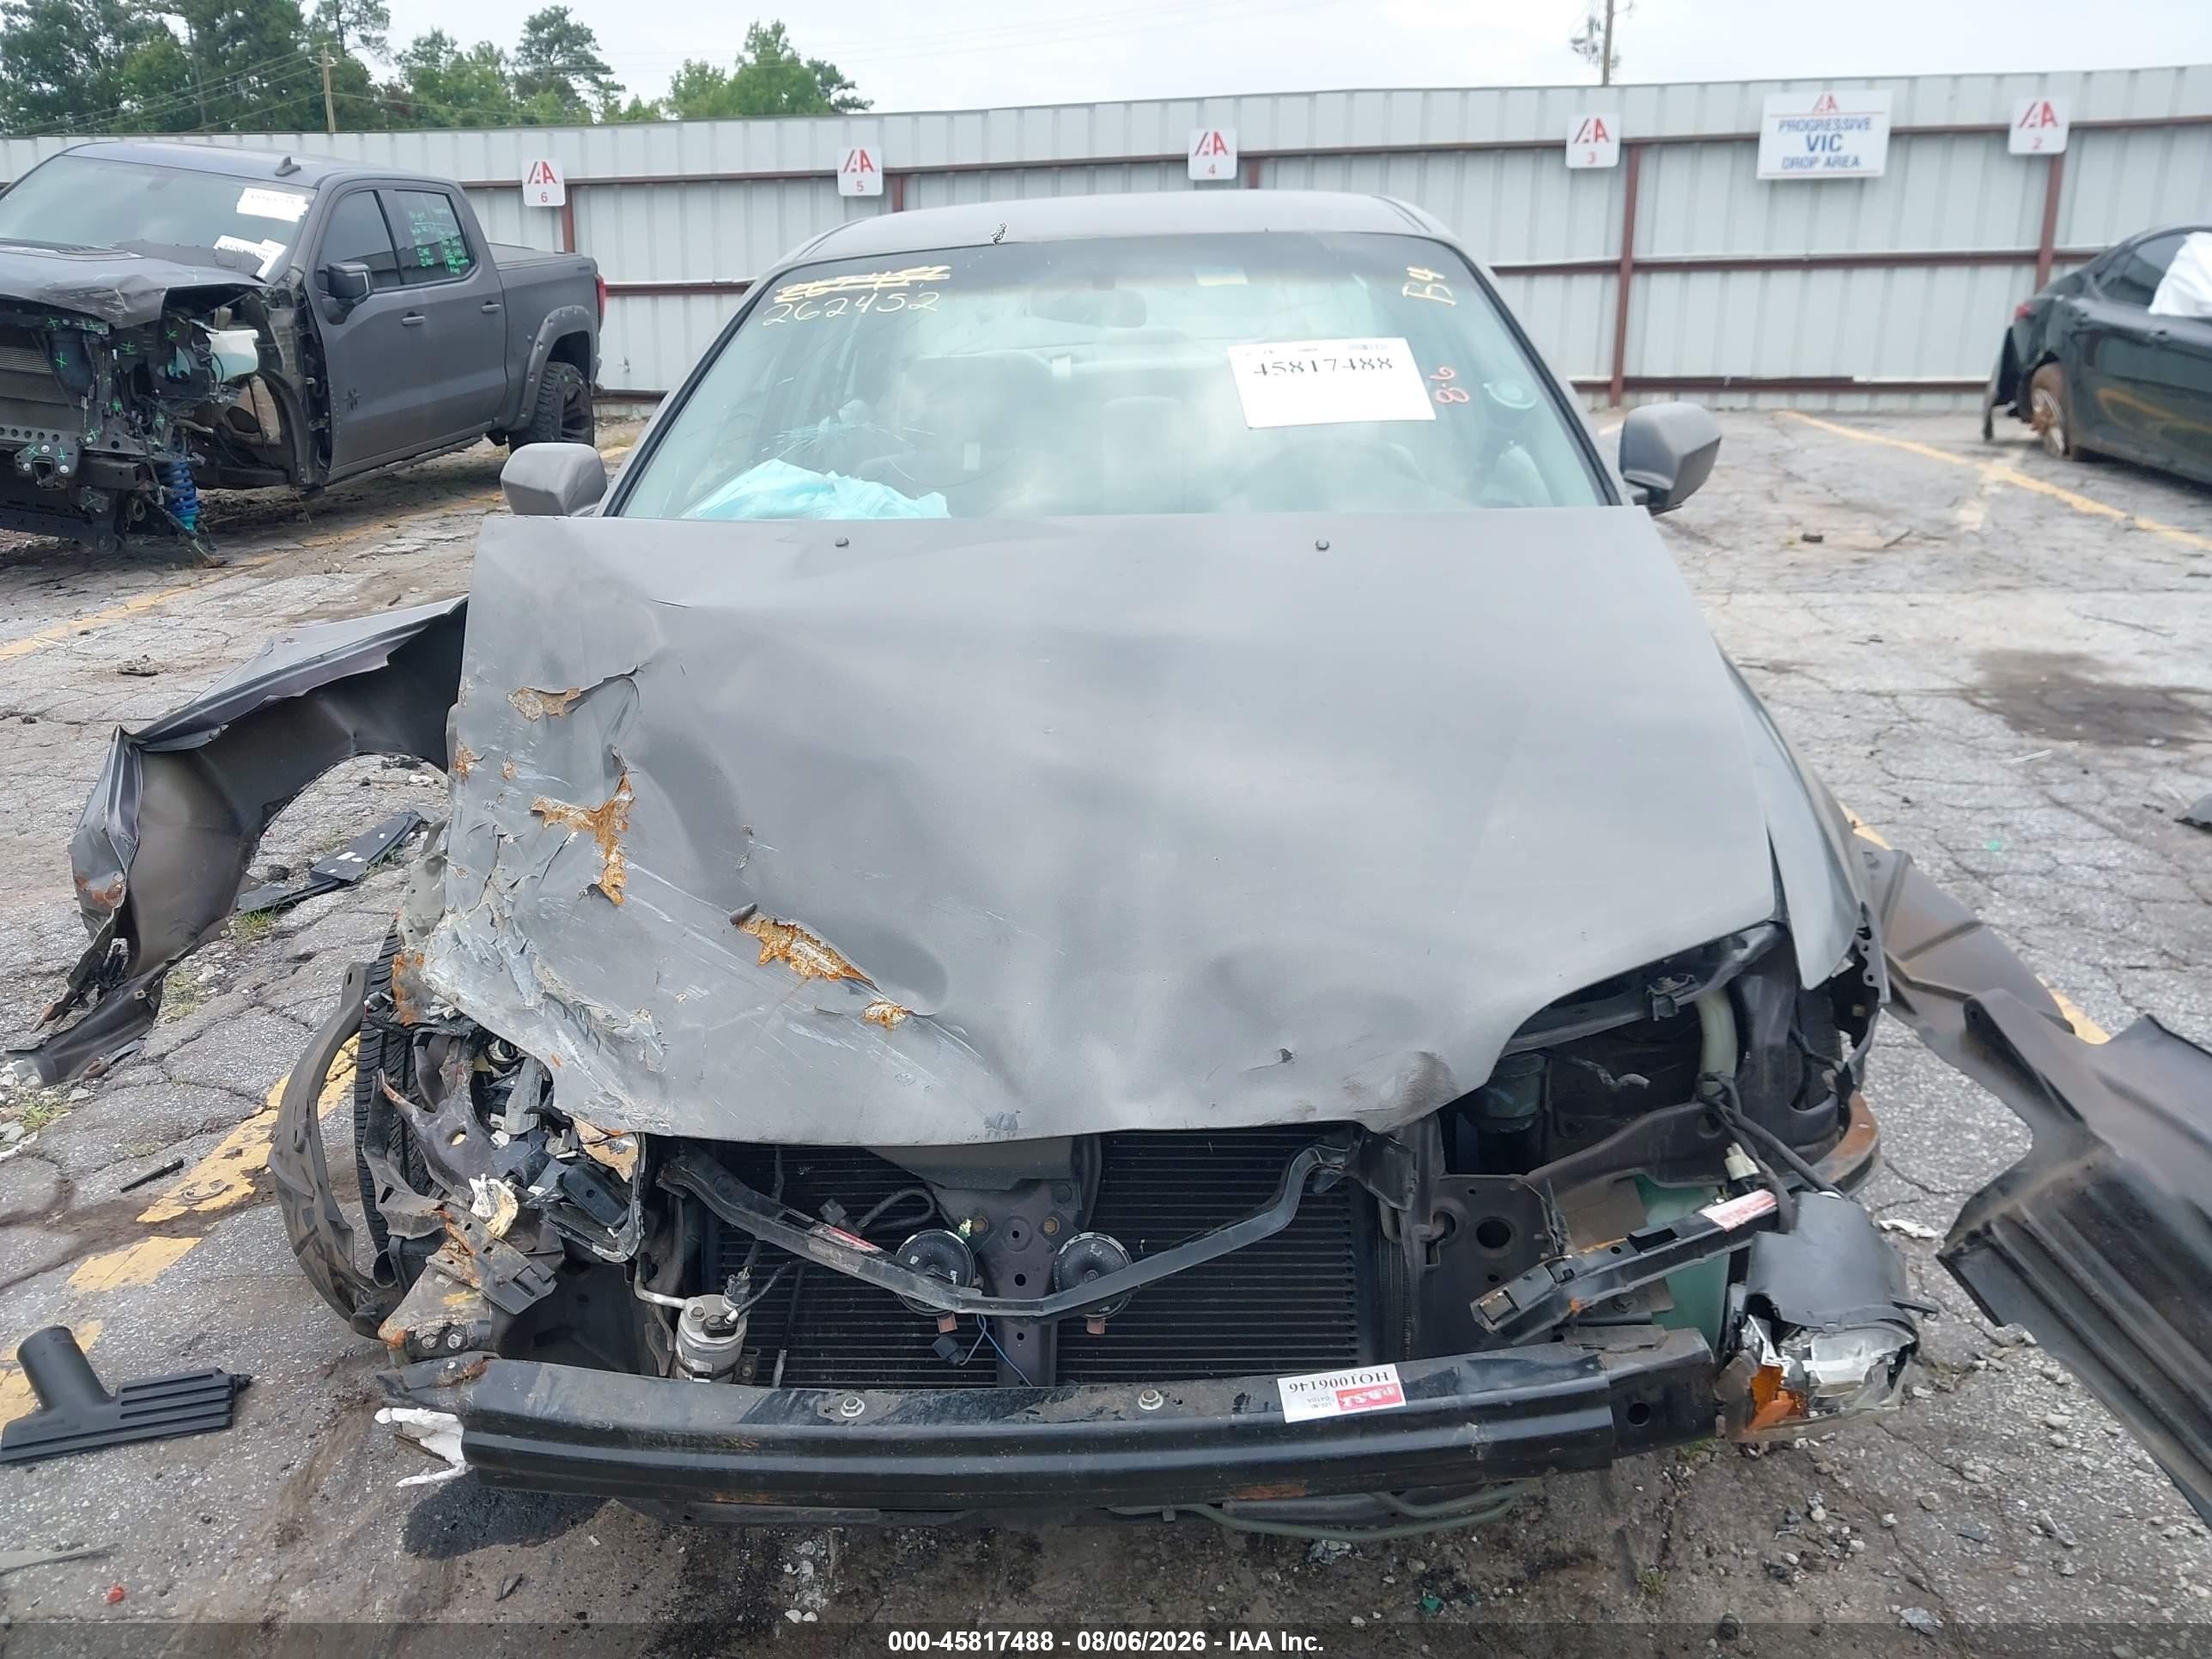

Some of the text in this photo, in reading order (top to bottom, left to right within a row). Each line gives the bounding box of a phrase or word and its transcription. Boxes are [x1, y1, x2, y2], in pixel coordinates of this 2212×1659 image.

[1778, 117, 1871, 132] PROGRESSIVE
[1807, 133, 1844, 152] VIC
[1587, 152, 1595, 165] 3
[1781, 155, 1862, 170] DROP AREA
[856, 179, 865, 193] 5
[541, 191, 549, 204] 6
[763, 291, 940, 326] 262452
[1254, 356, 1393, 376] 45817488
[1289, 1371, 1389, 1393] HO1006146
